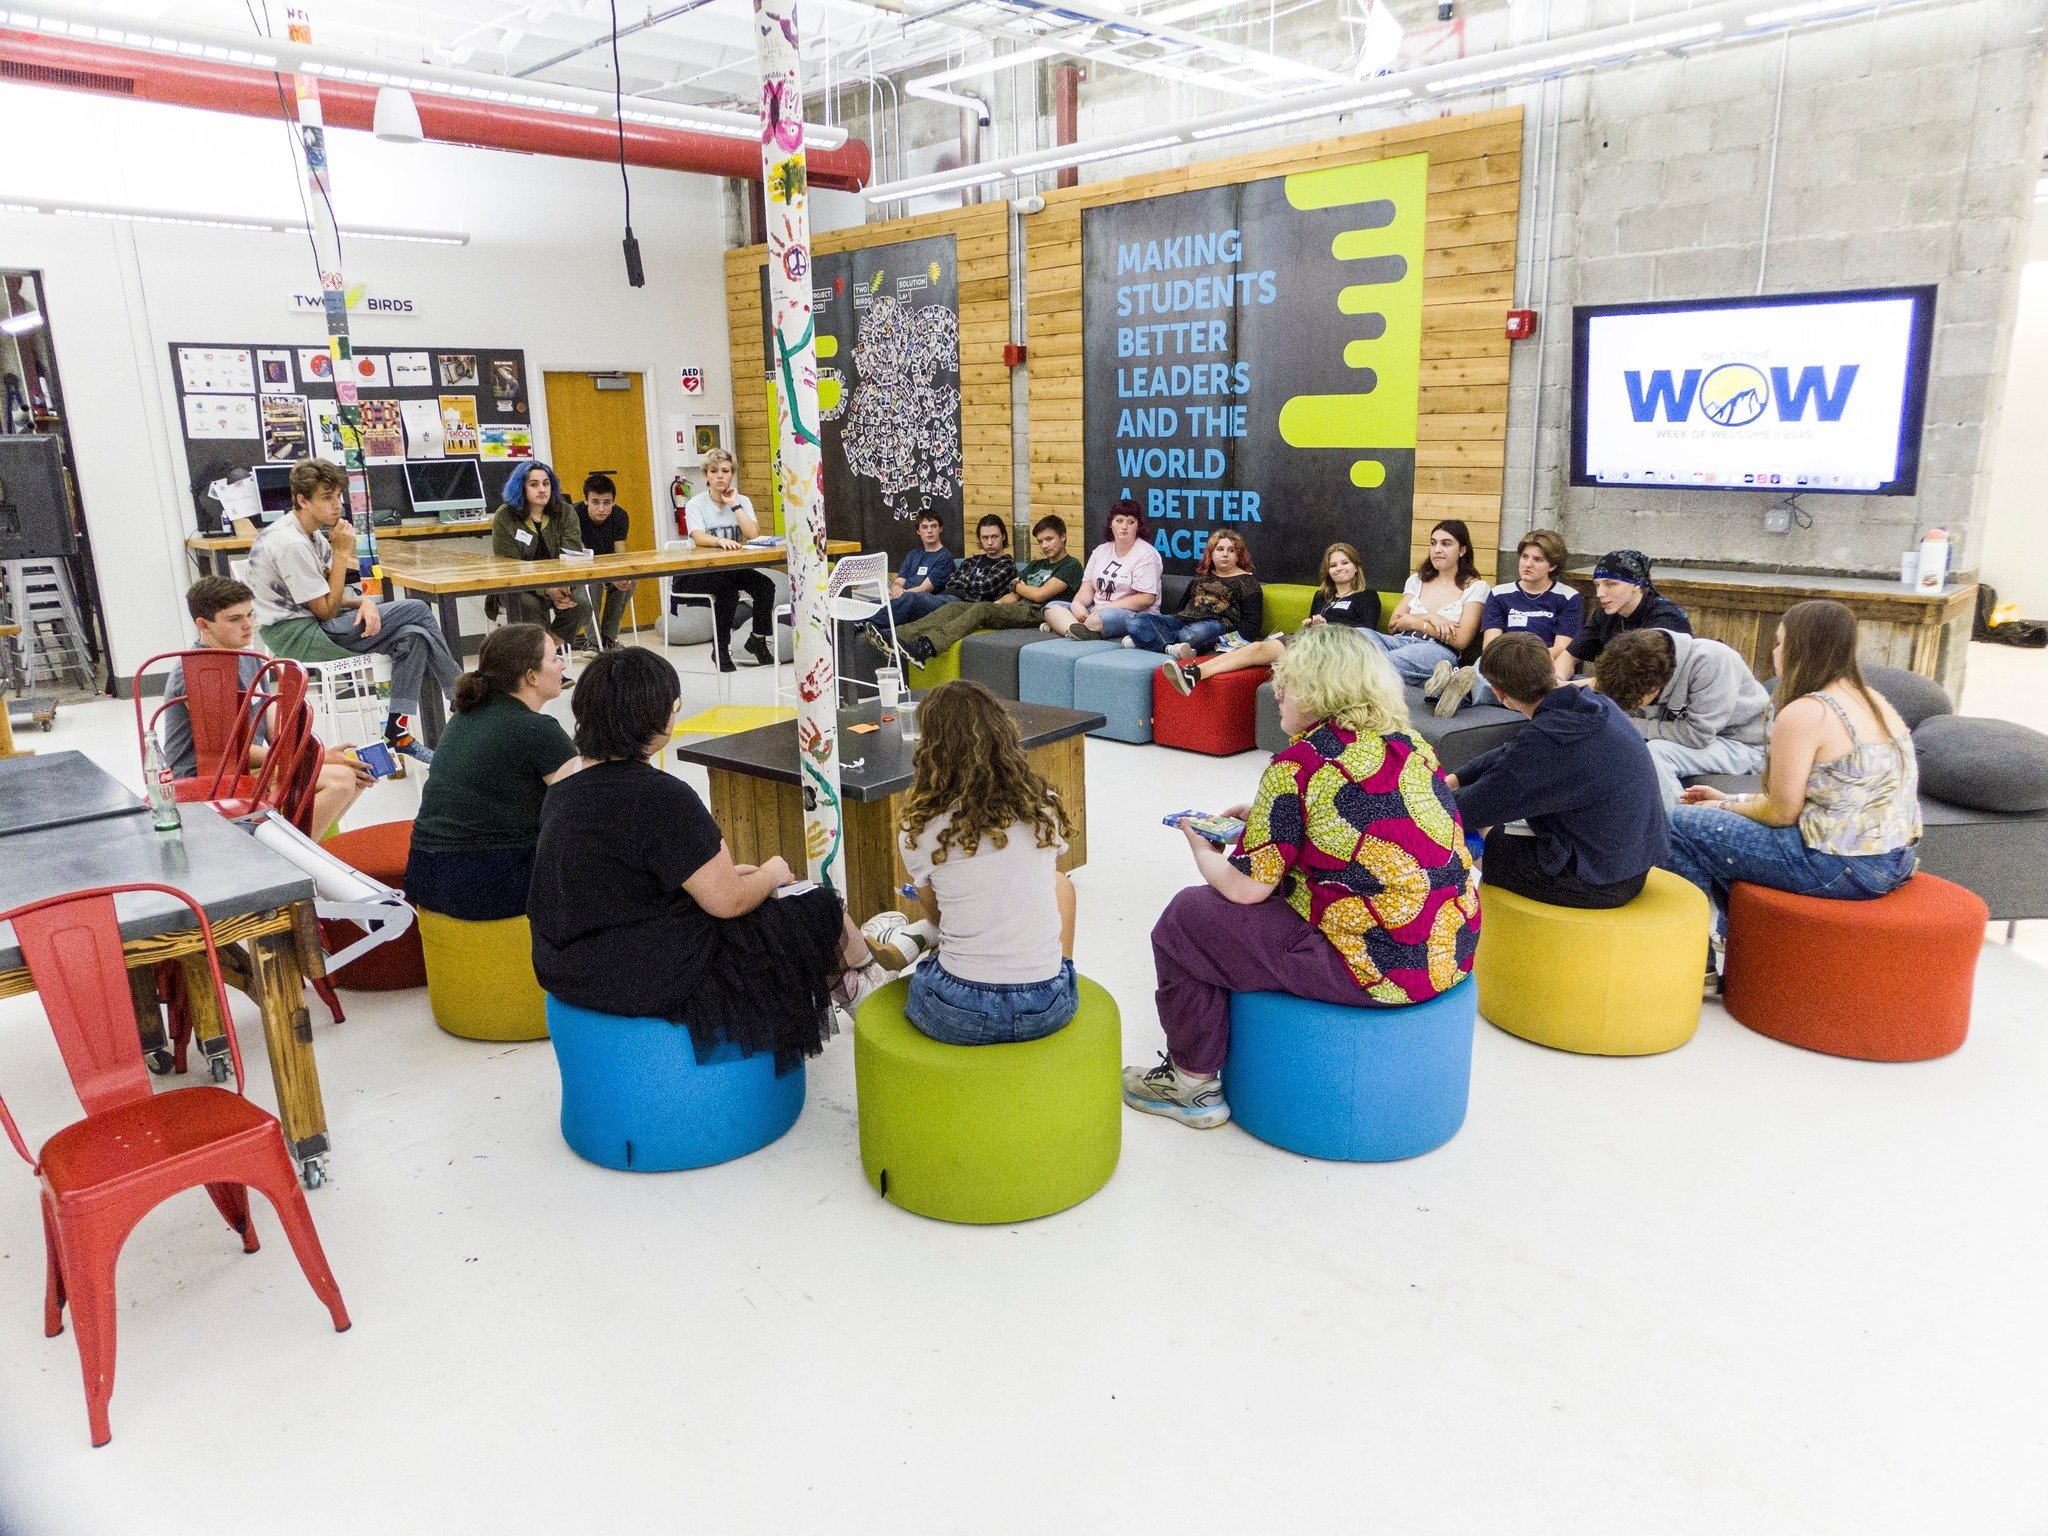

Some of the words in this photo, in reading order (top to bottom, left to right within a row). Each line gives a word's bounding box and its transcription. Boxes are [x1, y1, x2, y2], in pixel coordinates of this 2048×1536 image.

[1117, 229, 1242, 276] MAKING
[812, 290, 831, 299] ROJECT
[855, 286, 868, 294] TWO
[898, 278, 926, 289] SOLUTION
[1116, 270, 1277, 317] STUDENTS
[293, 295, 325, 307] TW
[367, 298, 414, 312] BIRDS
[813, 302, 824, 310] OOD
[1117, 319, 1229, 358] BETTER
[682, 368, 699, 377] AED
[1117, 361, 1251, 399] LEADERS
[1624, 362, 1861, 427] WOW
[448, 430, 475, 438] SKOOL
[1116, 407, 1178, 438] AND
[1185, 405, 1249, 438] THE
[1656, 429, 1687, 439] WEEK
[1691, 430, 1707, 439] OF
[1711, 429, 1771, 439] WELCOME
[1117, 448, 1226, 479] WORLD
[1148, 488, 1262, 522] BETTER
[1153, 528, 1209, 560] ACE
